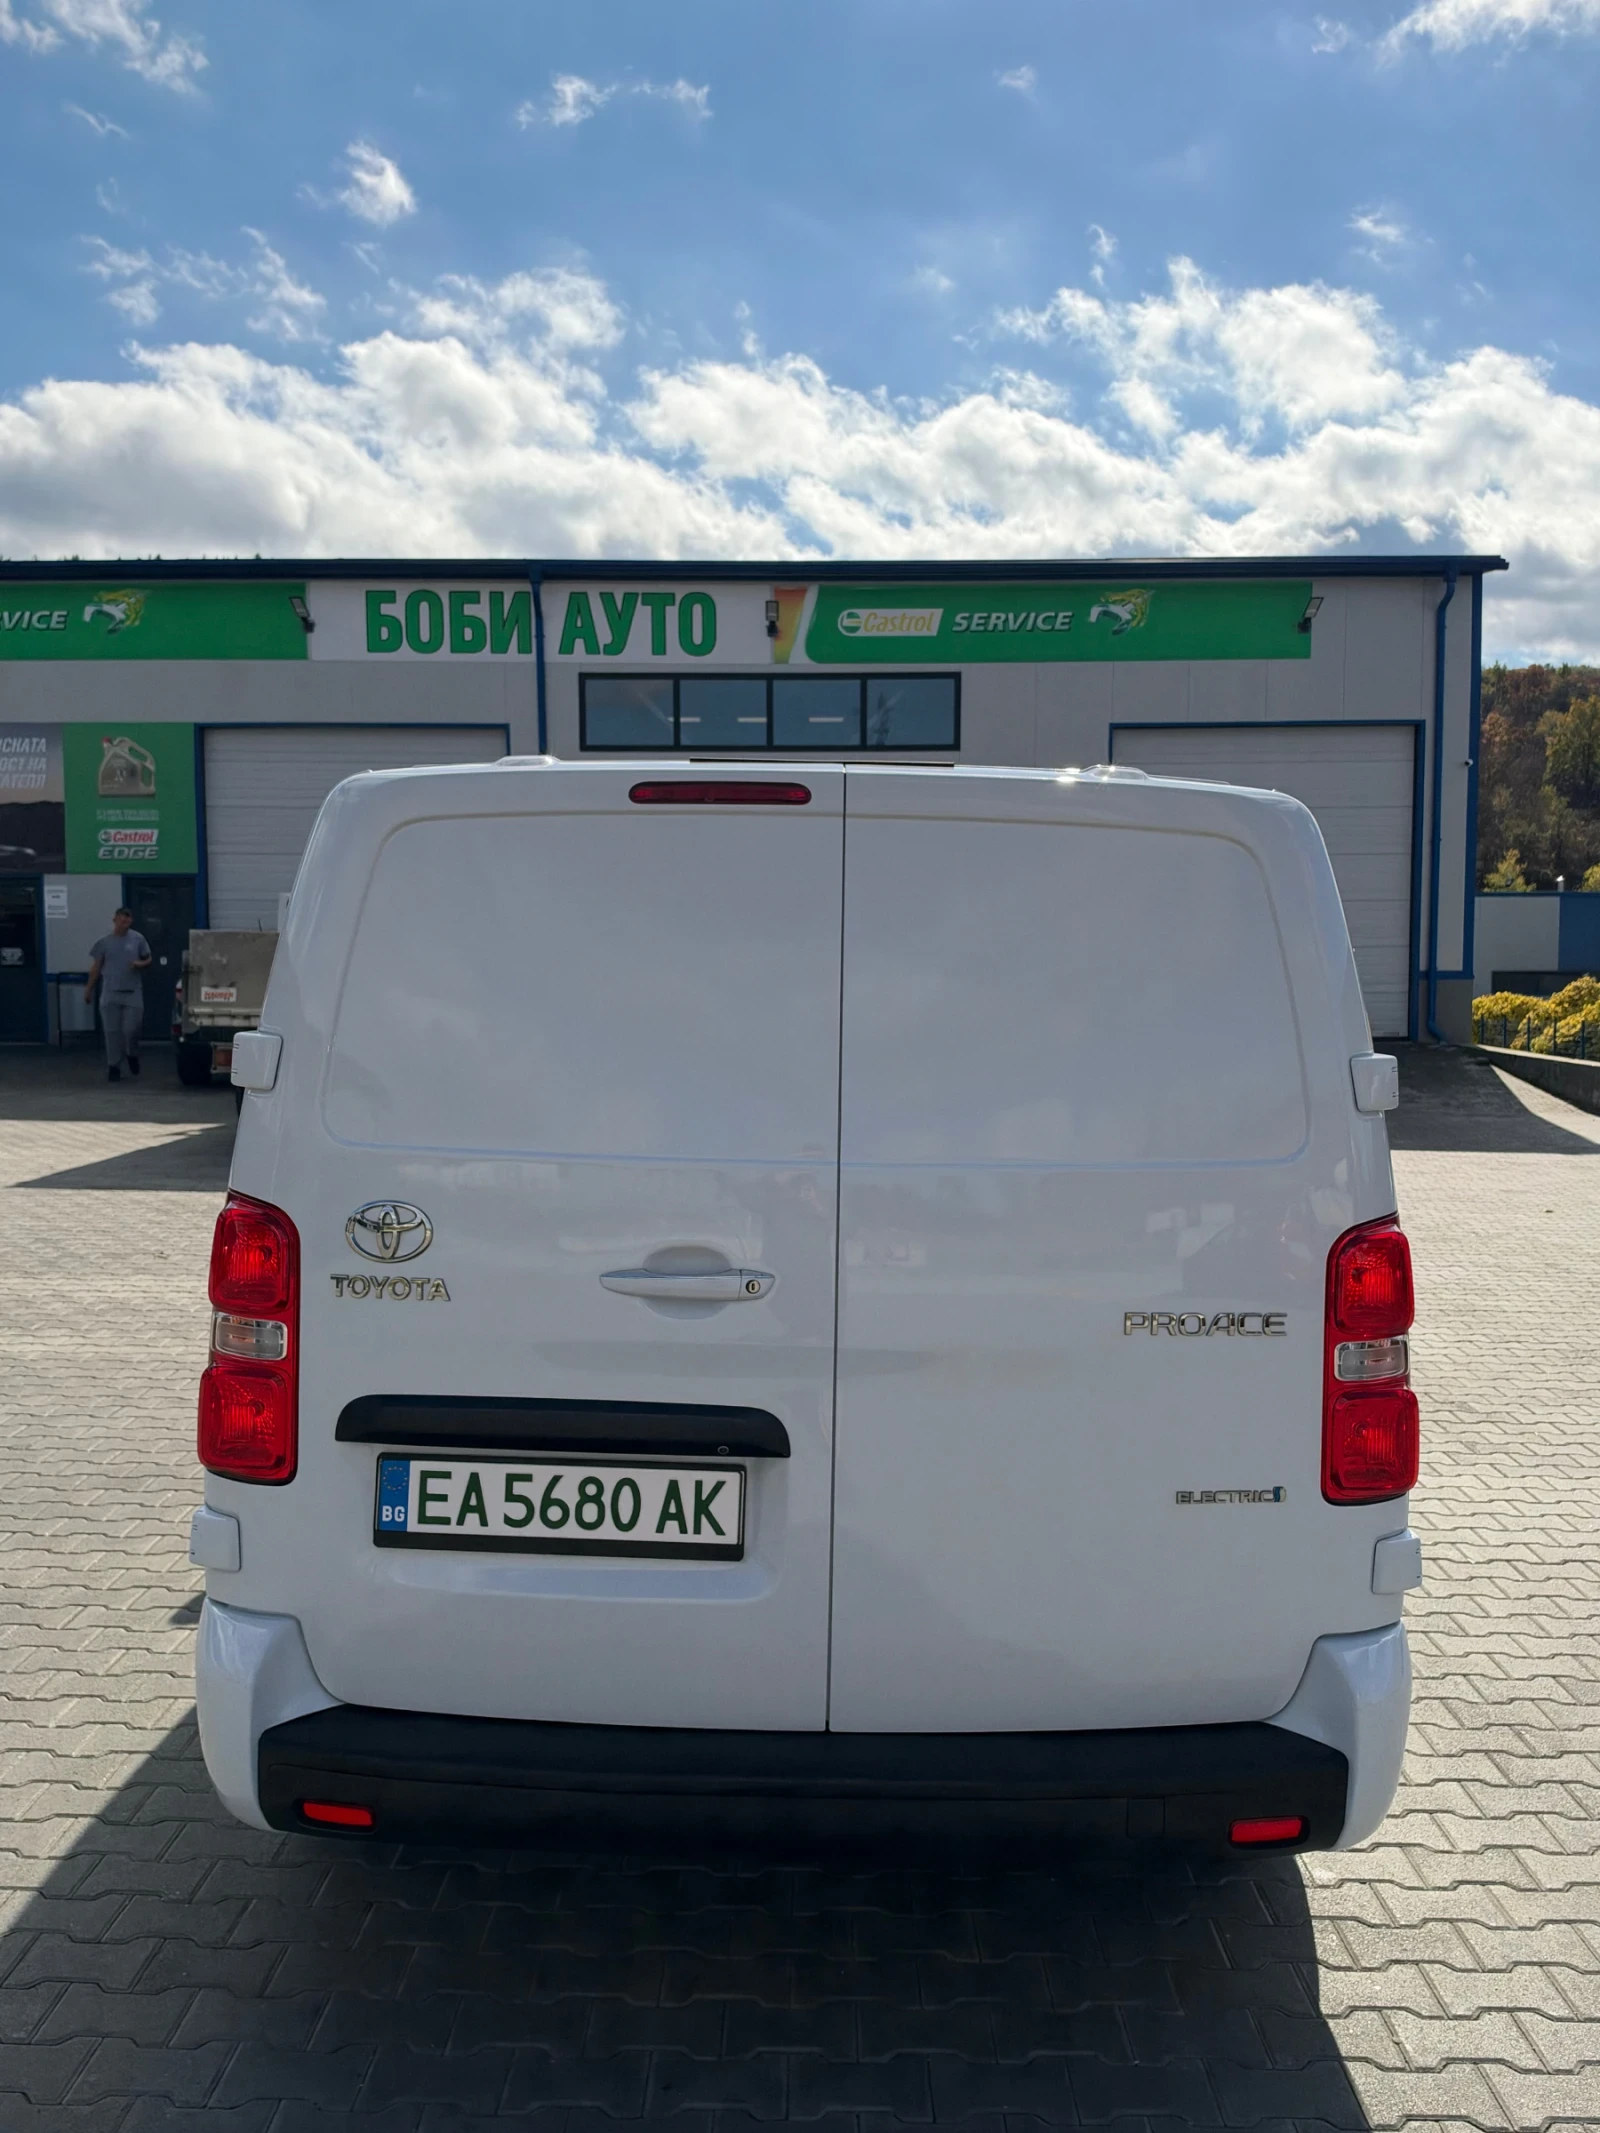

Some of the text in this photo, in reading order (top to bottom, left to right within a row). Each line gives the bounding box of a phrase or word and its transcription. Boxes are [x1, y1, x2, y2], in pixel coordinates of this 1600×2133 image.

[0, 610, 68, 630] VICE
[365, 589, 718, 657] БОБИ АУТО
[864, 611, 1073, 633] Castrol SERVICE
[112, 831, 154, 844] Castrol
[98, 846, 159, 860] EDGE
[330, 1274, 451, 1301] TOYOTA
[1124, 1312, 1288, 1337] PROACE
[417, 1470, 727, 1536] EA 5680 AK
[1176, 1490, 1275, 1505] ELECTRIC
[381, 1505, 406, 1523] BG
